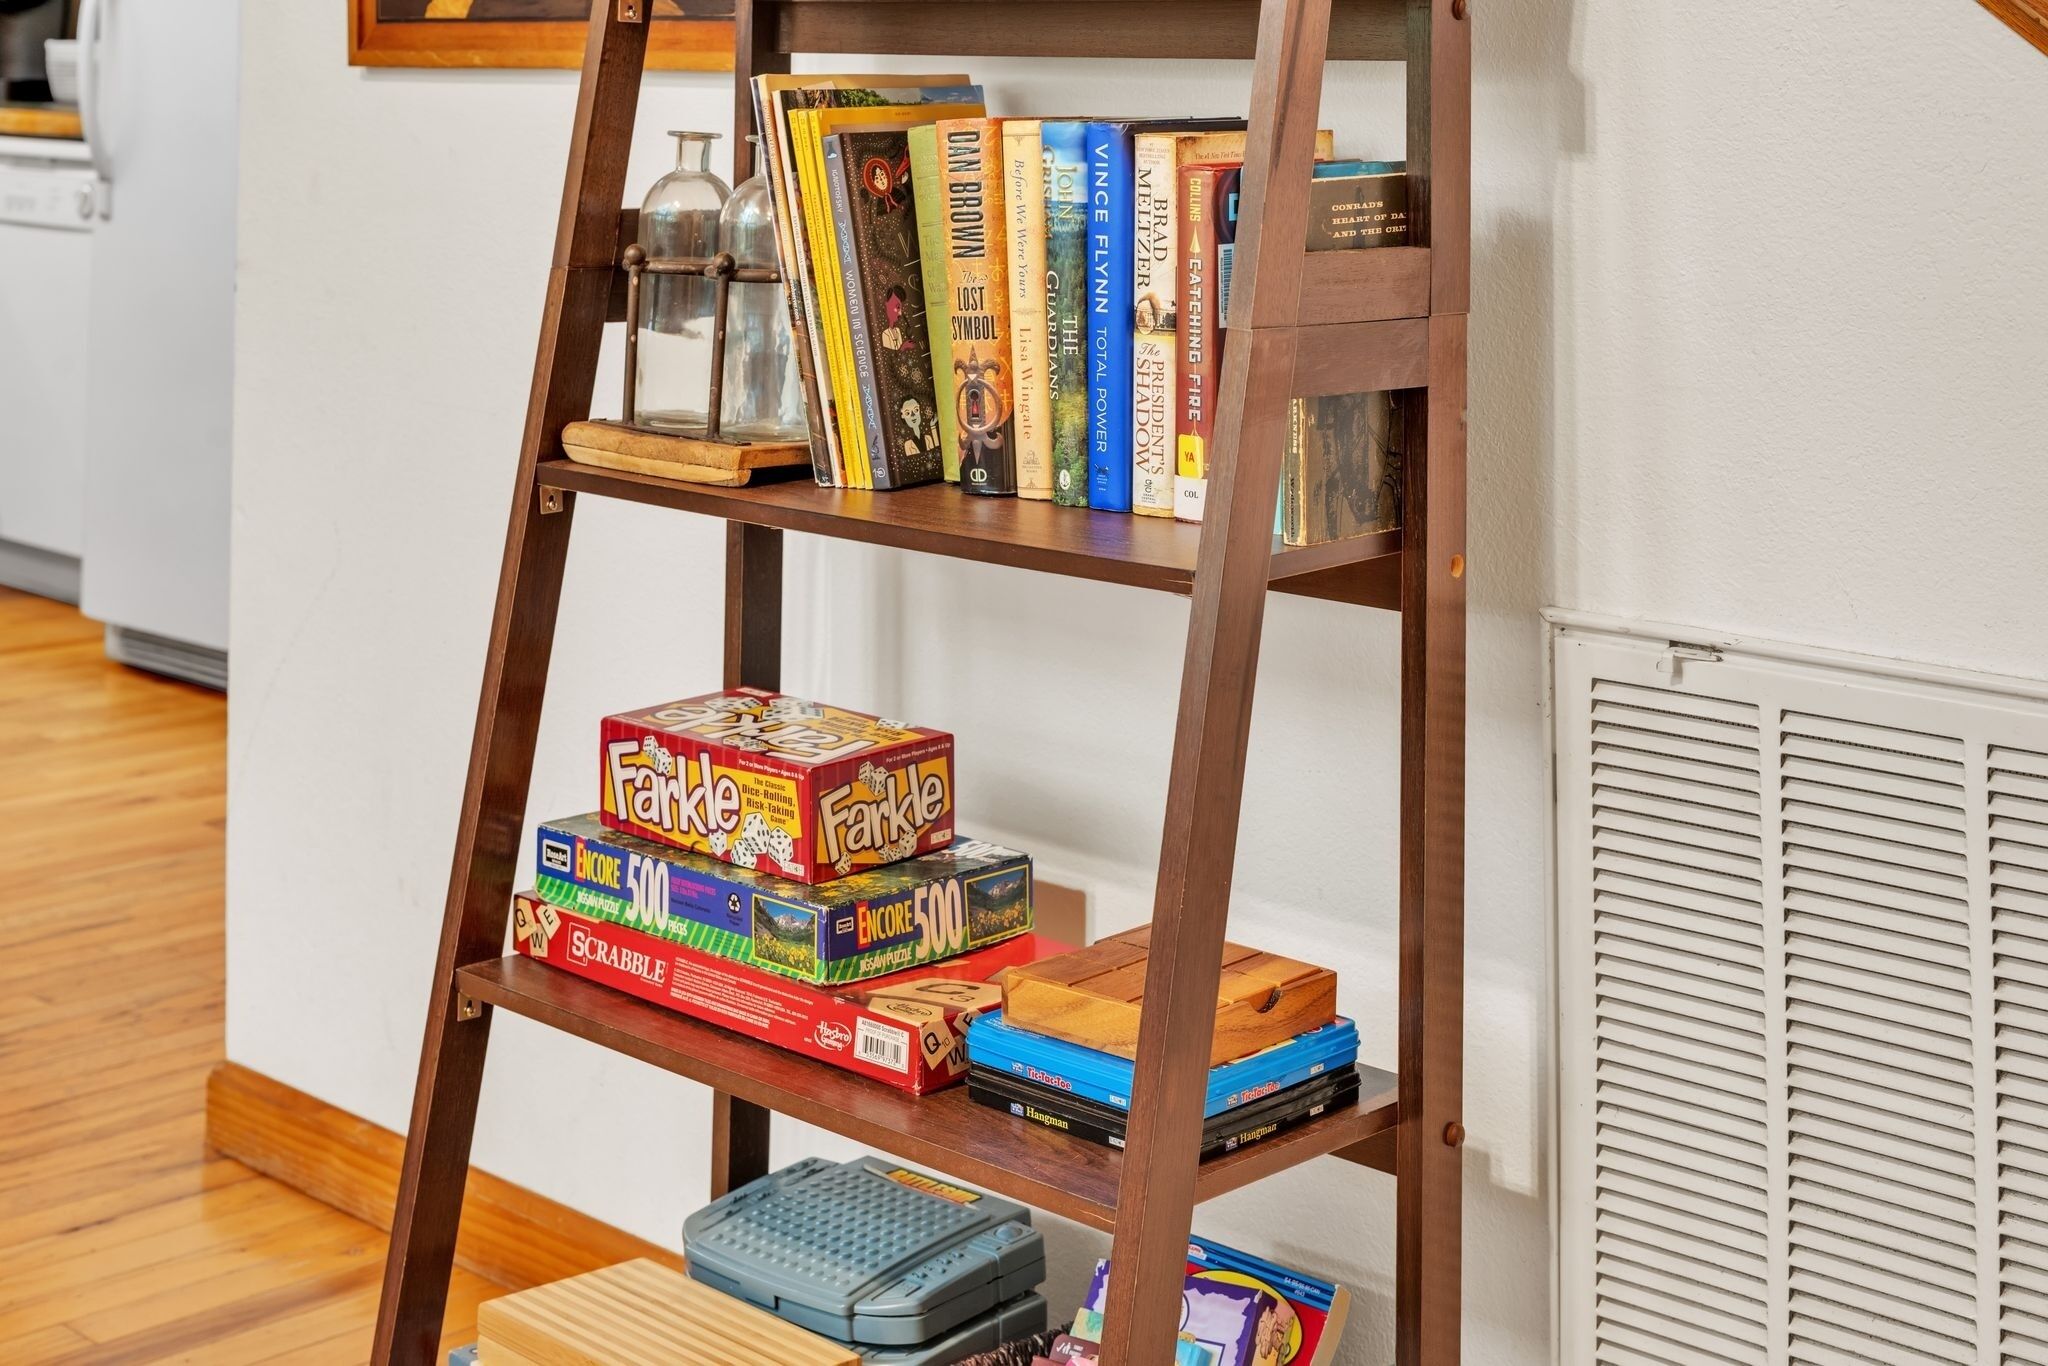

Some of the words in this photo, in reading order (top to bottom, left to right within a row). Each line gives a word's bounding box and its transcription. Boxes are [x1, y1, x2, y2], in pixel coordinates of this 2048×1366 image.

[947, 130, 982, 173] DAN
[1010, 159, 1028, 201] Before
[1055, 165, 1077, 221] JOHN
[1094, 143, 1109, 223] VINCE
[1016, 204, 1027, 226] We
[1189, 177, 1201, 222] COLLINS
[949, 181, 986, 259] BROWN
[1137, 168, 1152, 289] MELTZER
[1153, 198, 1168, 262] BRAD
[1332, 215, 1370, 225] HEART
[1332, 230, 1357, 239] AND
[1360, 227, 1382, 236] THE
[1016, 228, 1028, 260] Were
[962, 270, 978, 284] The
[1018, 264, 1028, 300] Yours
[1094, 234, 1109, 314] FLYNN
[846, 270, 858, 315] WOMEN
[957, 286, 985, 312] LOST
[853, 318, 861, 333] IN
[1188, 258, 1202, 363] CATCHING
[951, 315, 998, 341] SYMBOL
[1046, 270, 1060, 400] GUARDIANS
[1062, 315, 1078, 356] THE
[854, 334, 869, 378] SCIENCE
[1019, 328, 1032, 362] Lisa
[1096, 327, 1107, 383] TOTAL
[1138, 342, 1161, 357] The
[1019, 366, 1033, 440] Wingate
[1188, 373, 1201, 421] FIRE
[1096, 388, 1107, 452] POWER
[1136, 357, 1150, 474] SHADOW
[1151, 361, 1165, 475] PRESIDENT'S
[1184, 451, 1195, 463] YA
[1184, 489, 1199, 499] COL
[653, 706, 880, 765] Farkle
[754, 777, 764, 787] The
[765, 780, 786, 792] Classic
[764, 765, 779, 774] Players
[607, 738, 742, 837] Farkle
[742, 783, 796, 807] Dice-Rolling,
[746, 797, 795, 820] Risk-Taking
[770, 814, 786, 825] Game
[819, 762, 945, 864] Farkle
[576, 841, 621, 890] ENCORE
[625, 852, 670, 931] 500
[515, 908, 527, 928] Q
[543, 909, 554, 926] E
[668, 919, 688, 936] PIECES
[858, 899, 913, 944] ENCORE
[914, 878, 963, 959] 500
[531, 932, 544, 949] W
[571, 930, 667, 984] SCRABBLE
[859, 954, 887, 973] JIGSAW
[886, 946, 911, 966] PUZZLE
[816, 1020, 850, 1042] Hasbro
[820, 1034, 843, 1052] Gaming
[923, 1031, 942, 1055] Q
[948, 1043, 966, 1066] W
[1026, 1066, 1073, 1092] Tic-Tac-Toe
[1240, 1081, 1281, 1104] Tic-Tac-Toe
[1026, 1105, 1069, 1131] Hangman
[1239, 1123, 1277, 1145] Hangman
